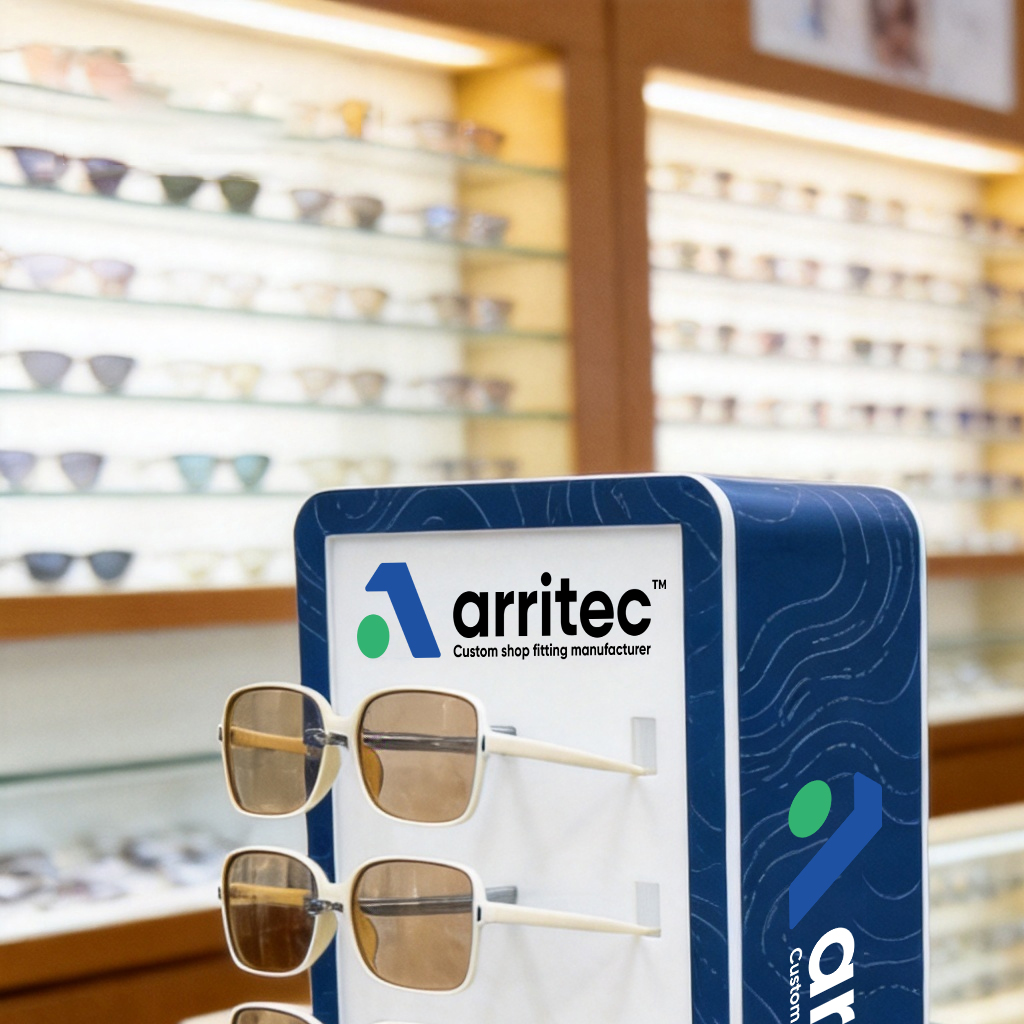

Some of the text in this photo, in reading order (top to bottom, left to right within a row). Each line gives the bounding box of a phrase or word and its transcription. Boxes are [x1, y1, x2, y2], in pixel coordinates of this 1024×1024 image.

[453, 571, 651, 638] arritec
[453, 642, 651, 660] Custom shop fitting manufacturer
[789, 947, 803, 1024] Custom
